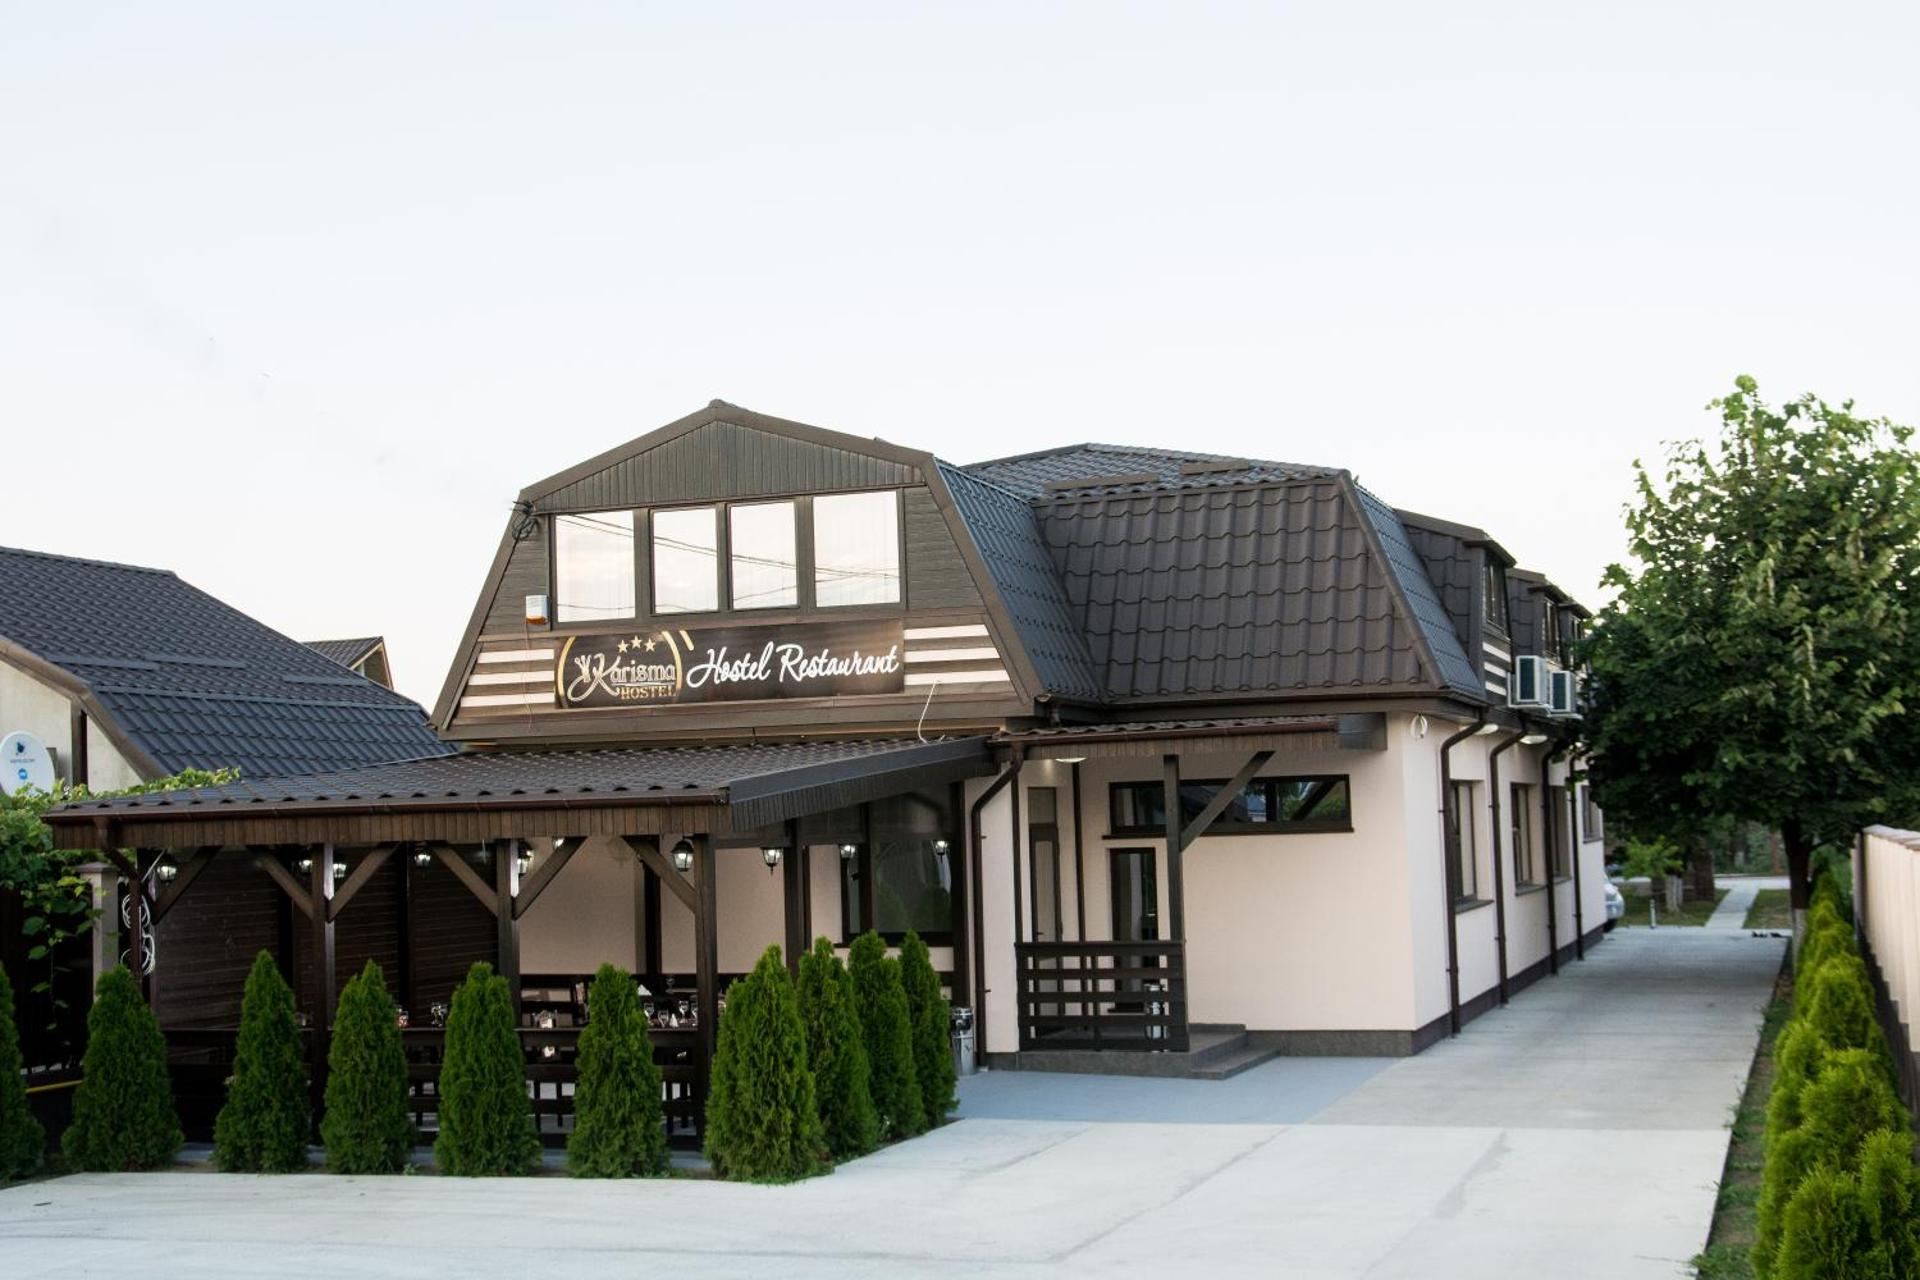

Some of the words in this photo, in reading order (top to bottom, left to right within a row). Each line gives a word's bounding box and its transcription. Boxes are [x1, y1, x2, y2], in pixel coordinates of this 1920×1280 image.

[567, 652, 676, 701] Karisma
[686, 641, 774, 688] Hostel
[775, 643, 900, 683] Restaurant
[620, 685, 677, 700] HOSTEL
